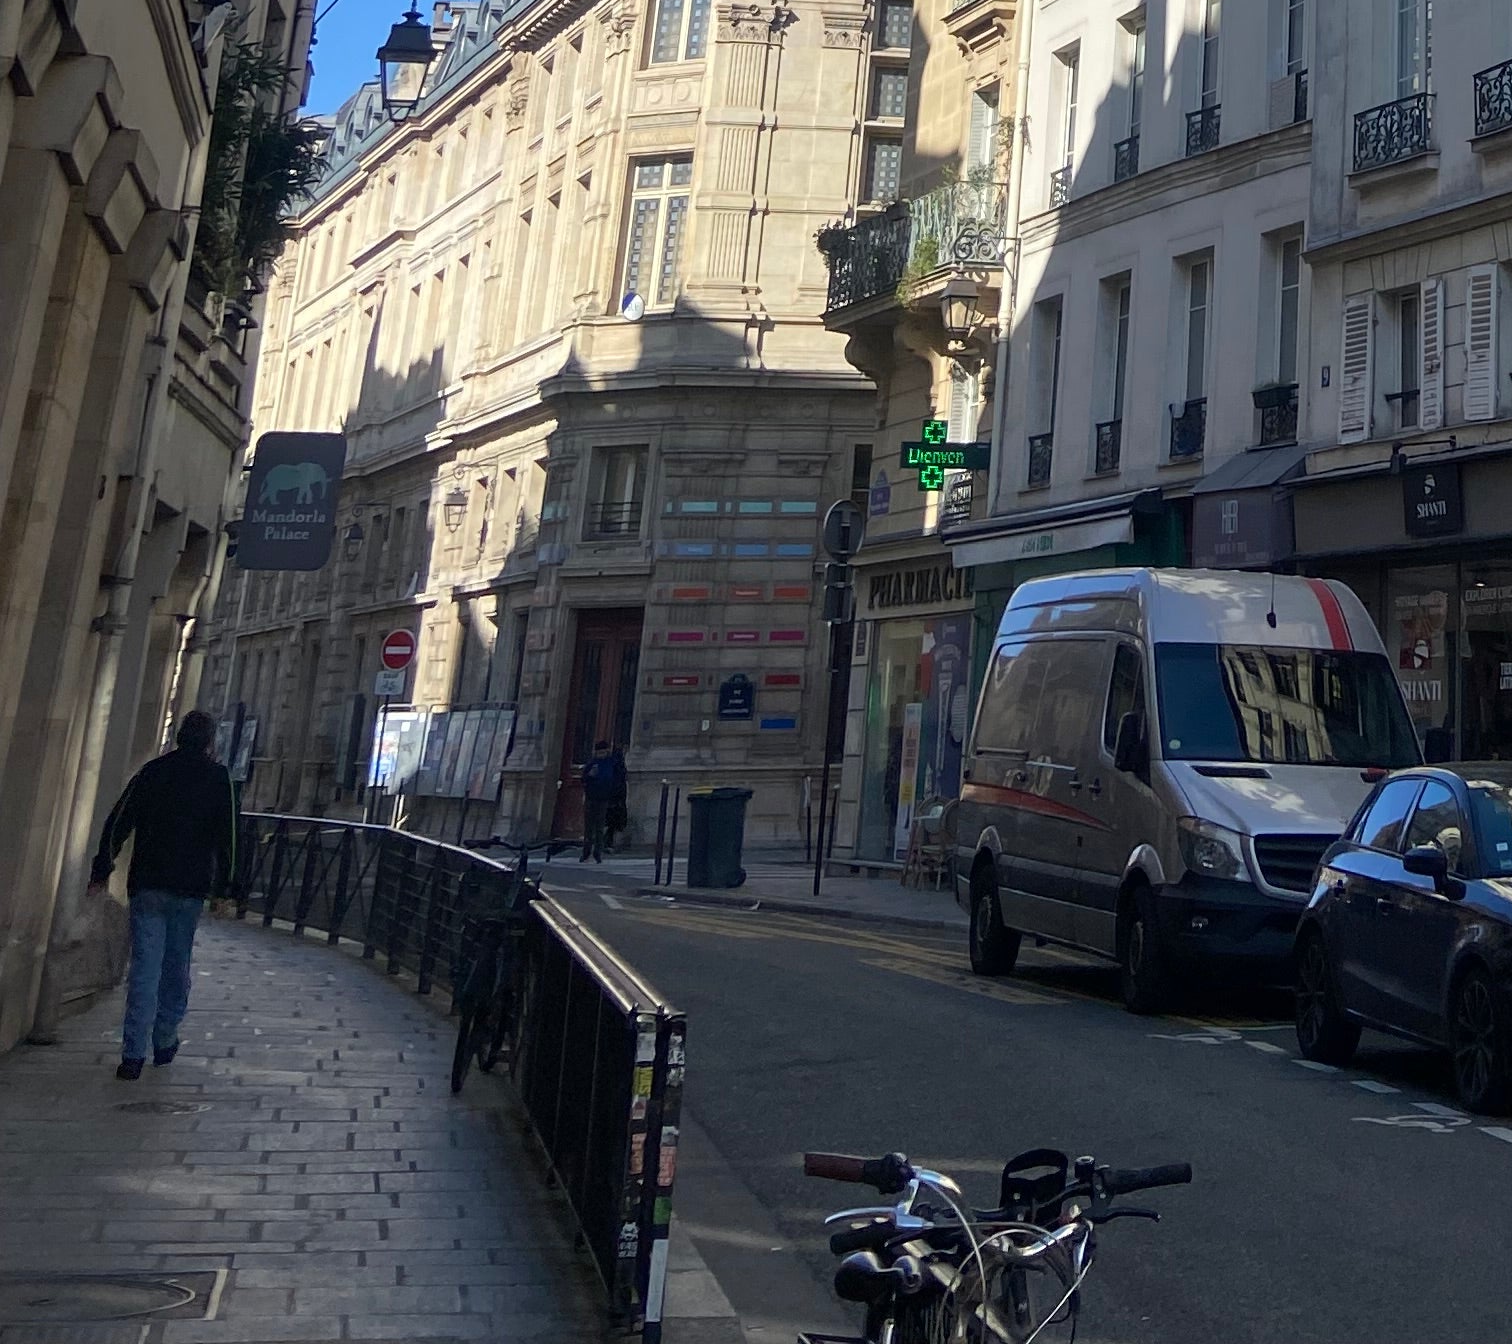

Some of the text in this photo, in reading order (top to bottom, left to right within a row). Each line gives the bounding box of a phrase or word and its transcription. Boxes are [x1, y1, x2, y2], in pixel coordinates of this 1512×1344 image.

[1416, 500, 1447, 519] SHANTI
[265, 526, 310, 540] Palace
[1401, 680, 1441, 701] SHANTI
